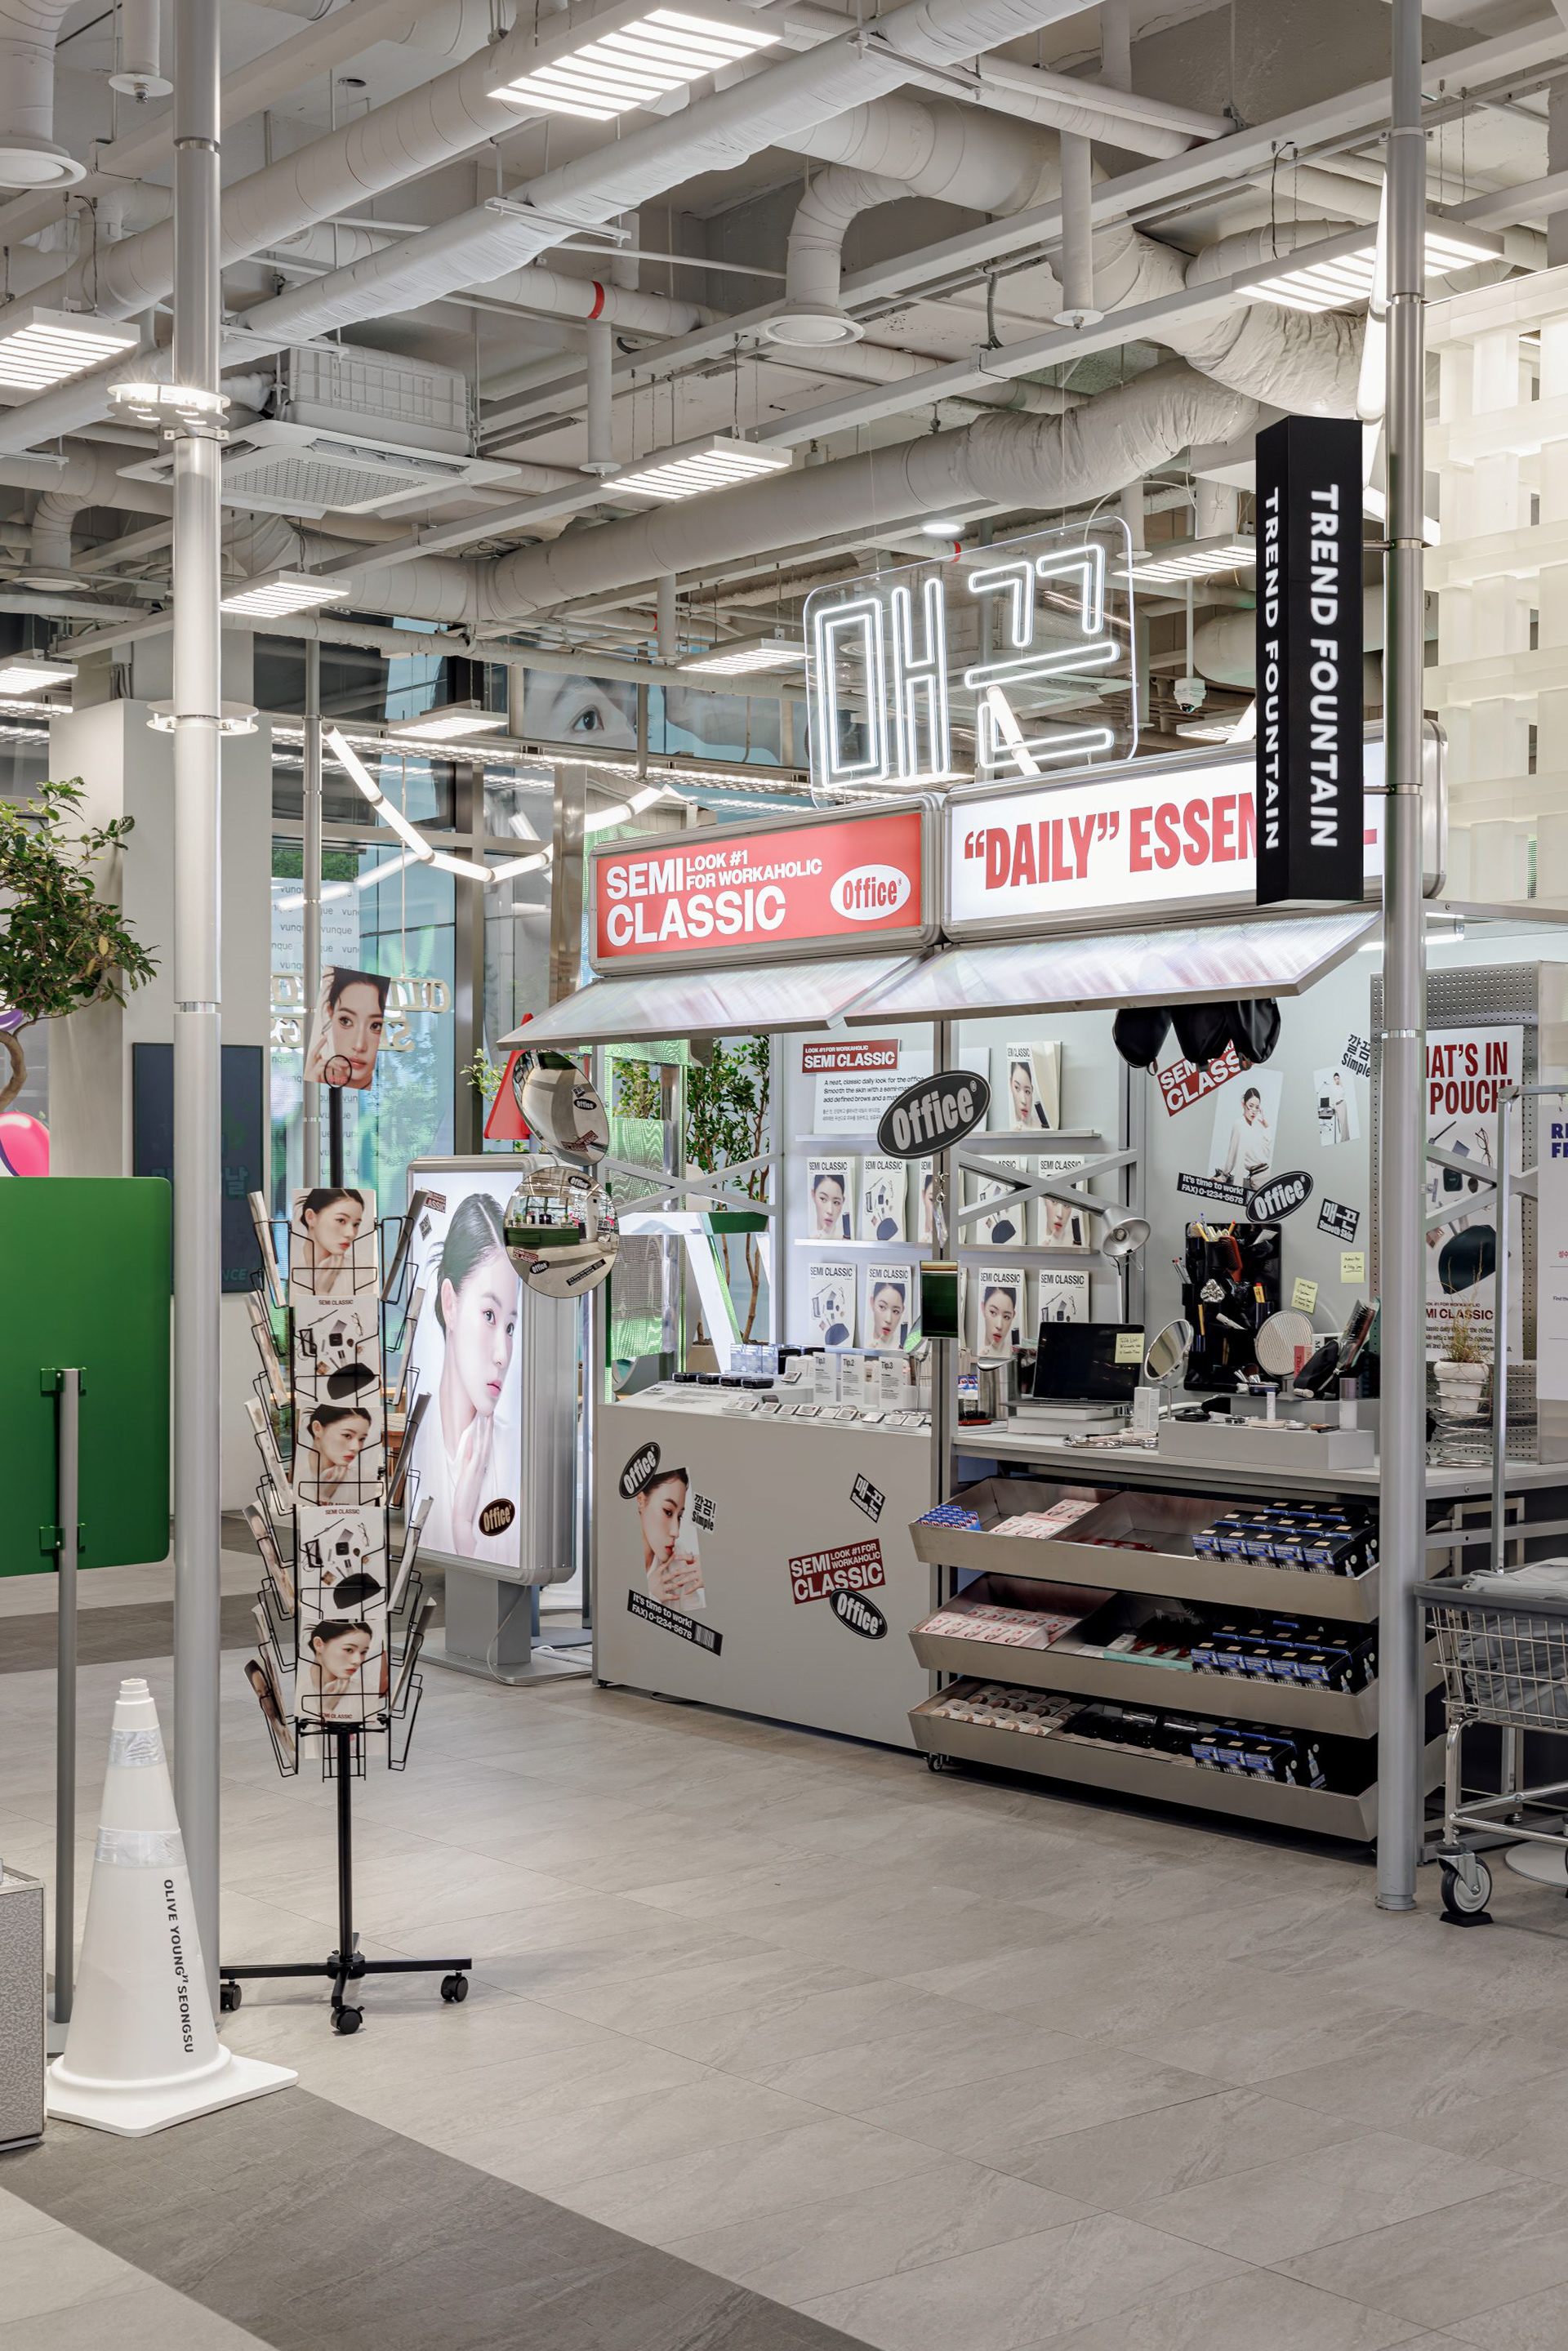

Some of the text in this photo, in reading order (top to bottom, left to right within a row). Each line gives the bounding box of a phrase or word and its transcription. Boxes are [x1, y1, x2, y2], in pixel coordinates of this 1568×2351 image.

[1265, 488, 1279, 849] TREND FOUNTAIN
[1311, 483, 1339, 848] TREND FOUNTAIN
[606, 849, 748, 900] SEMI LOOK #1
[686, 857, 822, 891] FOR WORKAHOLIC
[606, 885, 786, 947] CLASSIC
[804, 1051, 895, 1068] SEMI CLASSIC
[1486, 1041, 1508, 1075] IN
[808, 1162, 848, 1170] SEMI CLASSIC
[865, 1161, 902, 1170] SEMI CLASSIC
[921, 1161, 931, 1170] SEMI
[1040, 1160, 1054, 1169] SEMI
[1181, 1183, 1244, 1204] FAX) 0-1234-5678
[1182, 1174, 1244, 1196] It's time to work!
[810, 1267, 853, 1276] SEMI CLASSIC
[869, 1269, 909, 1279] SEMI CLASSIC
[980, 1272, 1021, 1283] SEMI CLASSIC
[1040, 1274, 1085, 1285] SEMI CLASSIC
[1439, 1308, 1494, 1320] CLASSIC
[692, 1511, 714, 1532] Simple
[791, 1543, 877, 1578] SEMI LOOK #1 FOR
[831, 1552, 881, 1570] WORKAHOLIC
[794, 1562, 883, 1601] CLASSIC
[632, 1592, 693, 1629] It's time to work!
[632, 1604, 693, 1640] FAX) 0-1234-5678
[163, 1879, 179, 1922] OLIVE
[176, 1986, 194, 2054] SEONGSU
